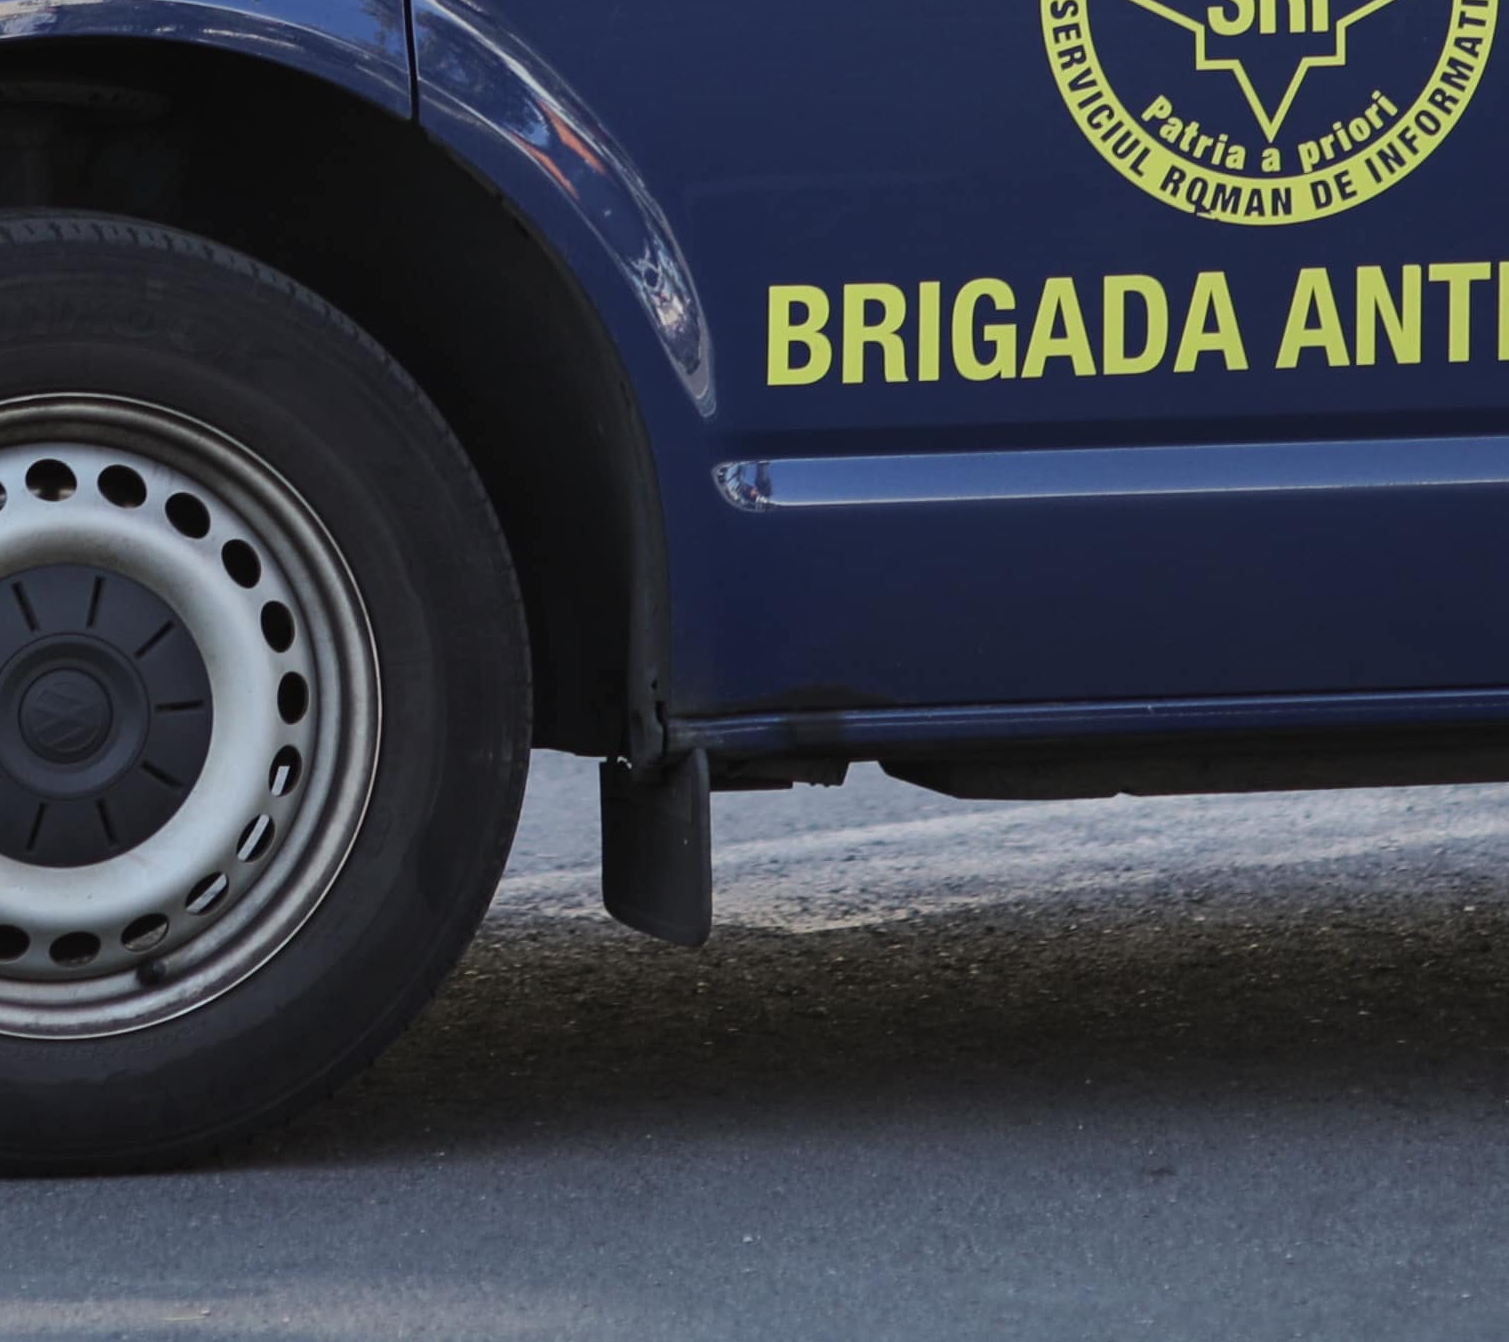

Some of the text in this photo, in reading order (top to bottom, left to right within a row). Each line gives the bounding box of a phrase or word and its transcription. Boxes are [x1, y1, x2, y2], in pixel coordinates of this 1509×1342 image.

[1141, 90, 1400, 174] Patria a priori
[1160, 165, 1292, 217] ROMAN
[1310, 169, 1357, 211] DE
[766, 270, 1249, 387] BRIGADA
